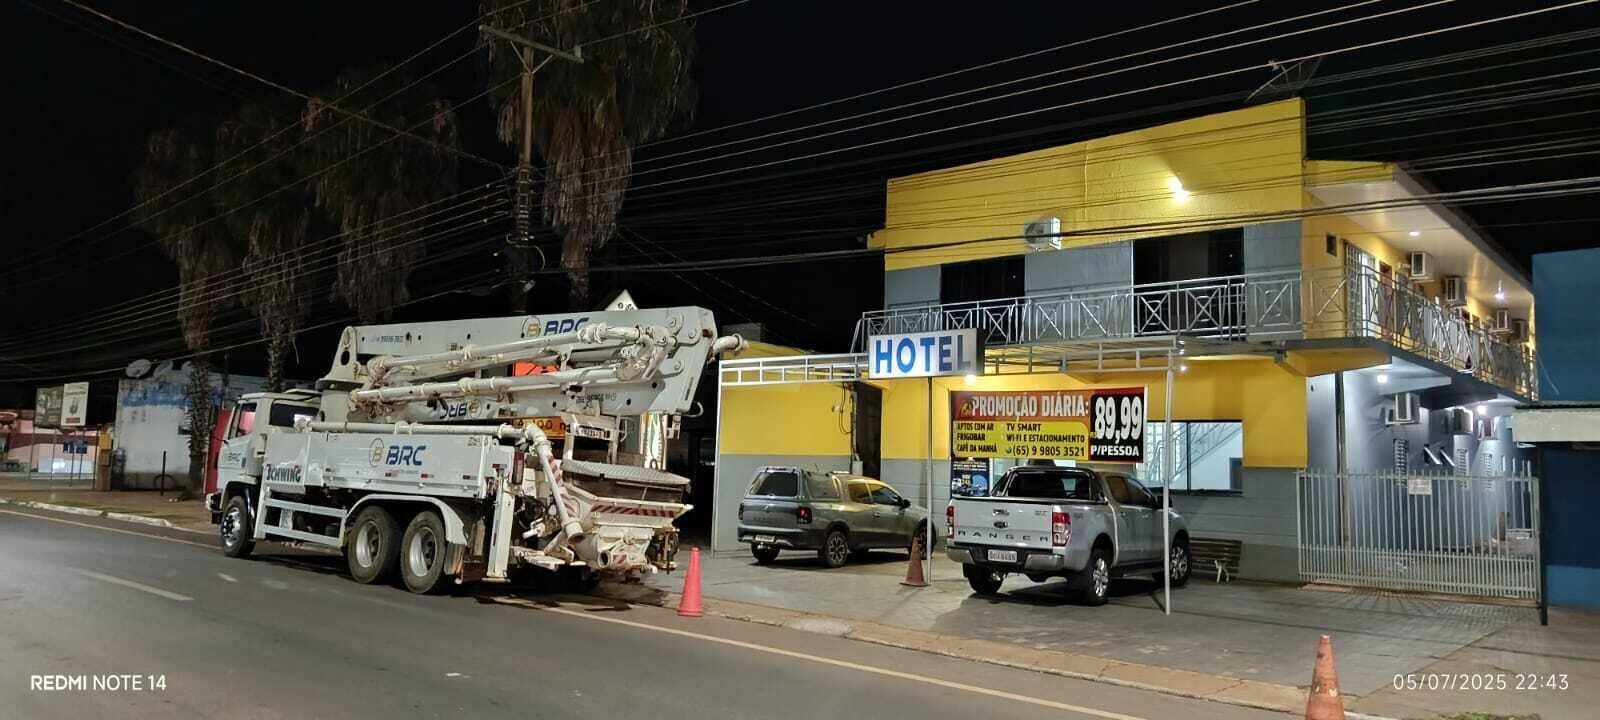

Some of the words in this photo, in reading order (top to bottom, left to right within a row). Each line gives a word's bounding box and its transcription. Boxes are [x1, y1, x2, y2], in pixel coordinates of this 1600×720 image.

[875, 335, 971, 374] HOTEL
[1041, 391, 1088, 417] DIÁRIA:
[1094, 396, 1142, 445] 89,99
[974, 423, 986, 431] COM
[987, 423, 994, 431] AR
[1006, 423, 1016, 431] TV
[1017, 423, 1042, 432] SMART
[957, 432, 986, 441] FRIGOBAR
[1023, 434, 1028, 442] E
[1029, 434, 1085, 443] ESTACIONAMENTO
[385, 445, 427, 466] BRC
[1012, 445, 1029, 457] (65)
[1032, 445, 1037, 456] 9
[1040, 446, 1061, 457] 9805
[1063, 446, 1085, 457] 3521
[1090, 445, 1139, 457] P/PESSOA
[957, 529, 1049, 543] RANGER
